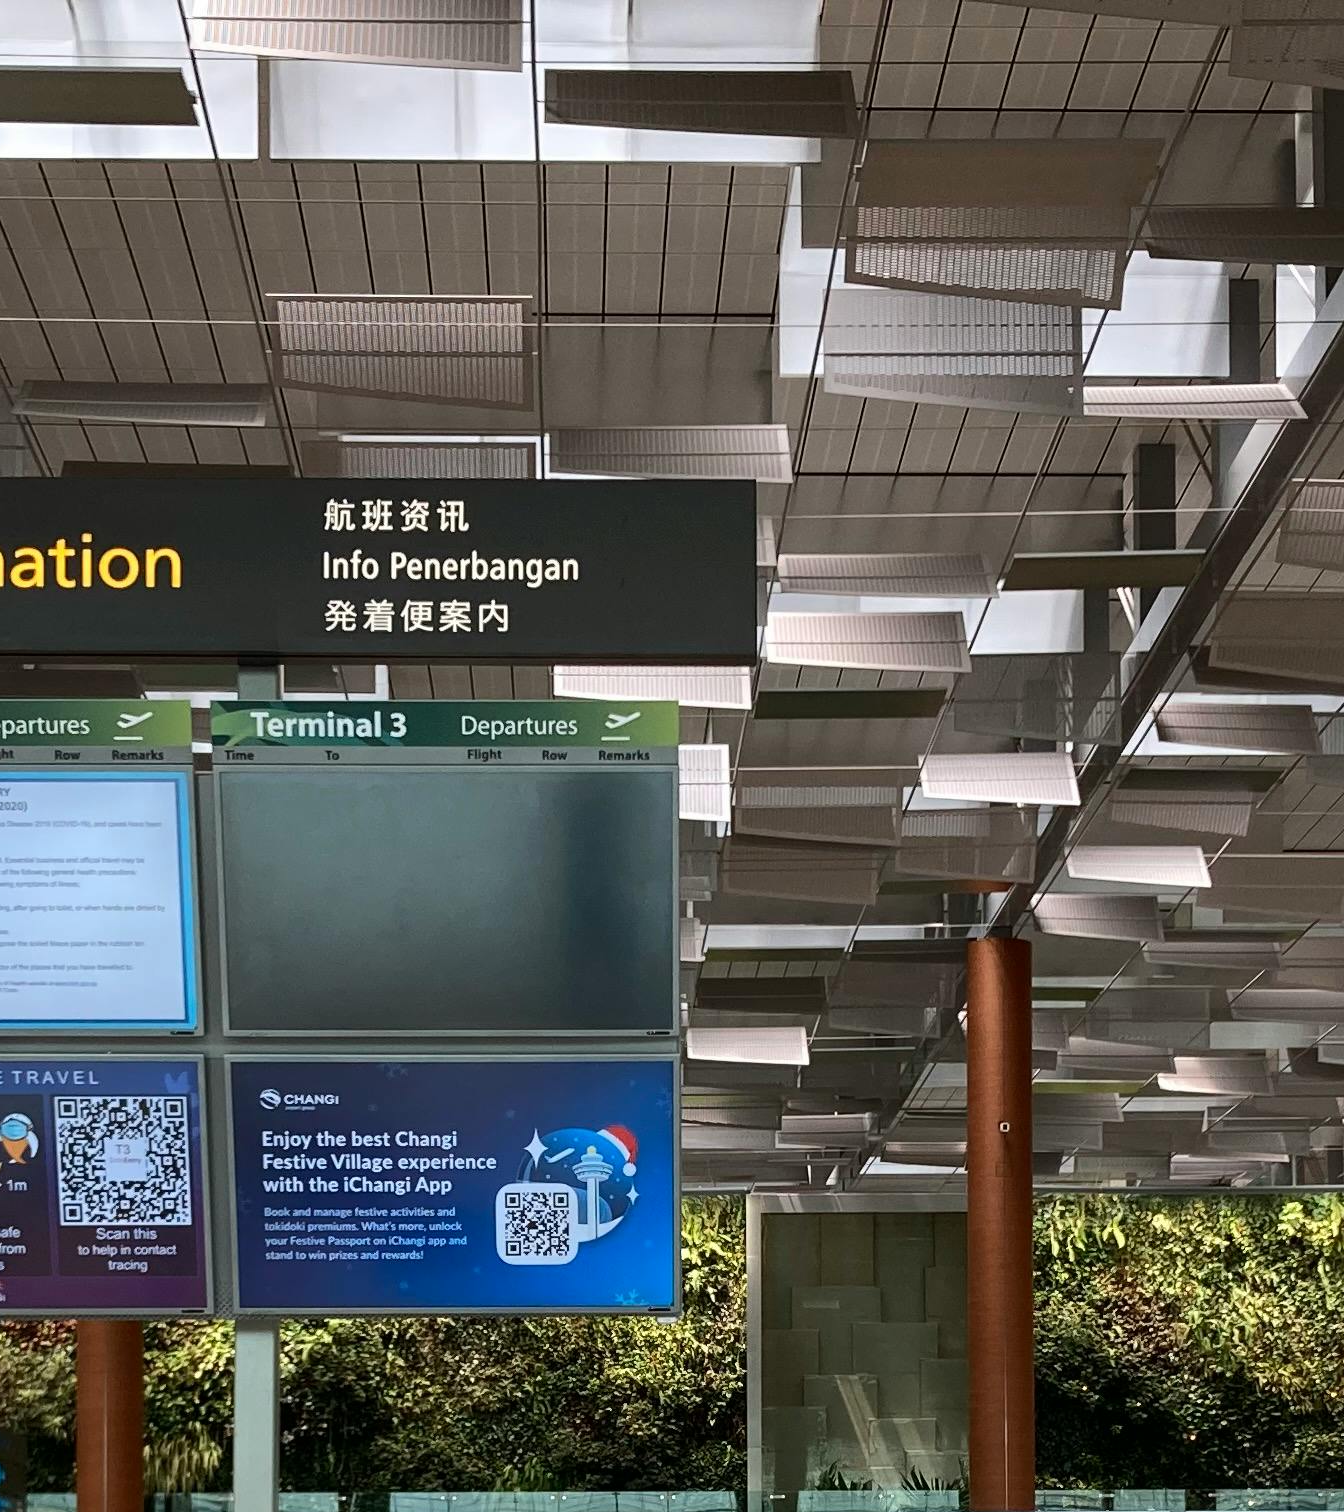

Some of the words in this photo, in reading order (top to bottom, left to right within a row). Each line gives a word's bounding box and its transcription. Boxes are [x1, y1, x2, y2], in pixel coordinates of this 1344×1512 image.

[324, 499, 469, 532] 航班资讯
[324, 549, 379, 579] Info
[391, 550, 578, 588] Penerbangan
[325, 599, 508, 632] 発着便案内
[249, 711, 381, 737] Terminal
[390, 713, 406, 737] 3
[462, 716, 577, 739] Departures
[55, 750, 80, 760] Row
[112, 750, 164, 760] Remarks
[12, 1071, 98, 1084] TRAVEL
[284, 1095, 338, 1104] CHANGI
[115, 1144, 130, 1154] T3
[263, 1131, 312, 1150] Enjoy
[316, 1131, 346, 1146] the
[352, 1131, 390, 1146] best
[395, 1131, 457, 1150] Changi
[263, 1154, 327, 1169] Festive
[331, 1154, 392, 1172] Village
[398, 1154, 496, 1172] experience
[263, 1177, 303, 1192] with
[309, 1177, 338, 1192] the
[344, 1177, 410, 1195] iChangi
[415, 1177, 452, 1195] App
[264, 1207, 290, 1216] Book
[291, 1207, 310, 1217] and
[314, 1209, 352, 1218] manage
[355, 1207, 388, 1216] festive
[390, 1207, 435, 1216] activities
[437, 1207, 455, 1216] and
